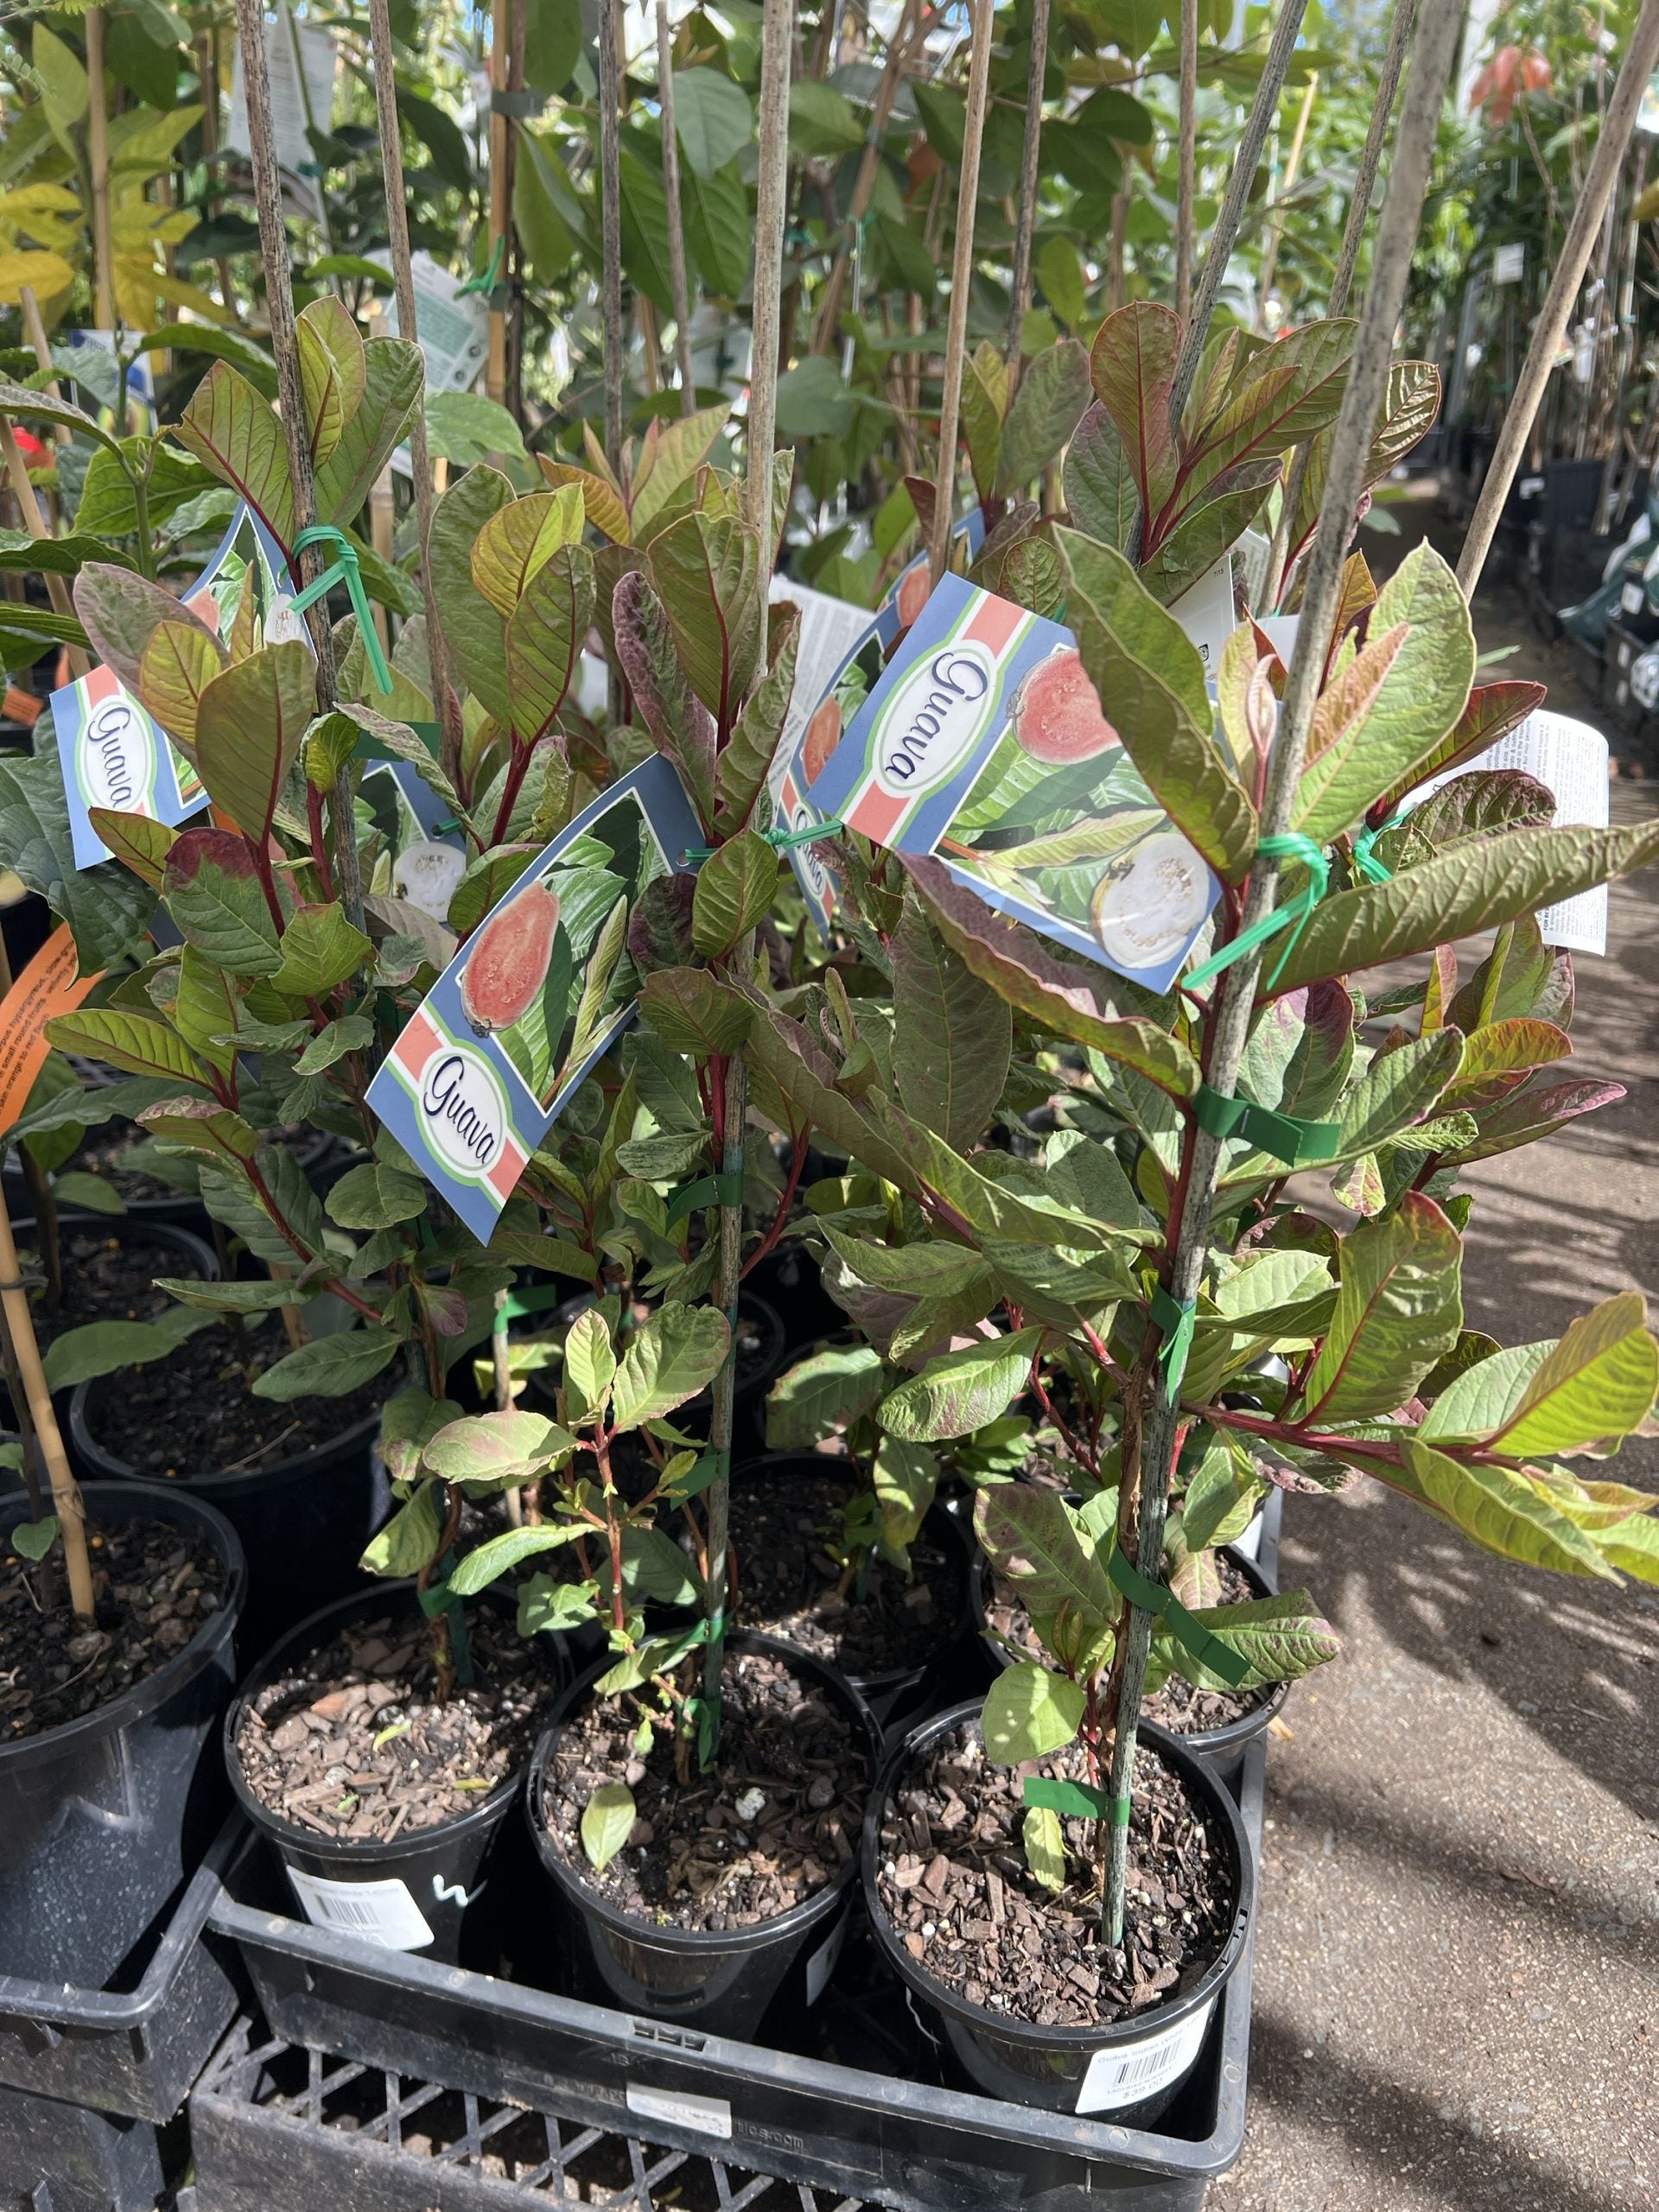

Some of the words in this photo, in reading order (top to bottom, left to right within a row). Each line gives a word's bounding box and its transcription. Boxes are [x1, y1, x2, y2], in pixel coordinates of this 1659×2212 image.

[87, 707, 131, 809] Guava
[885, 652, 988, 779] Guava
[423, 1056, 495, 1164] Guava
